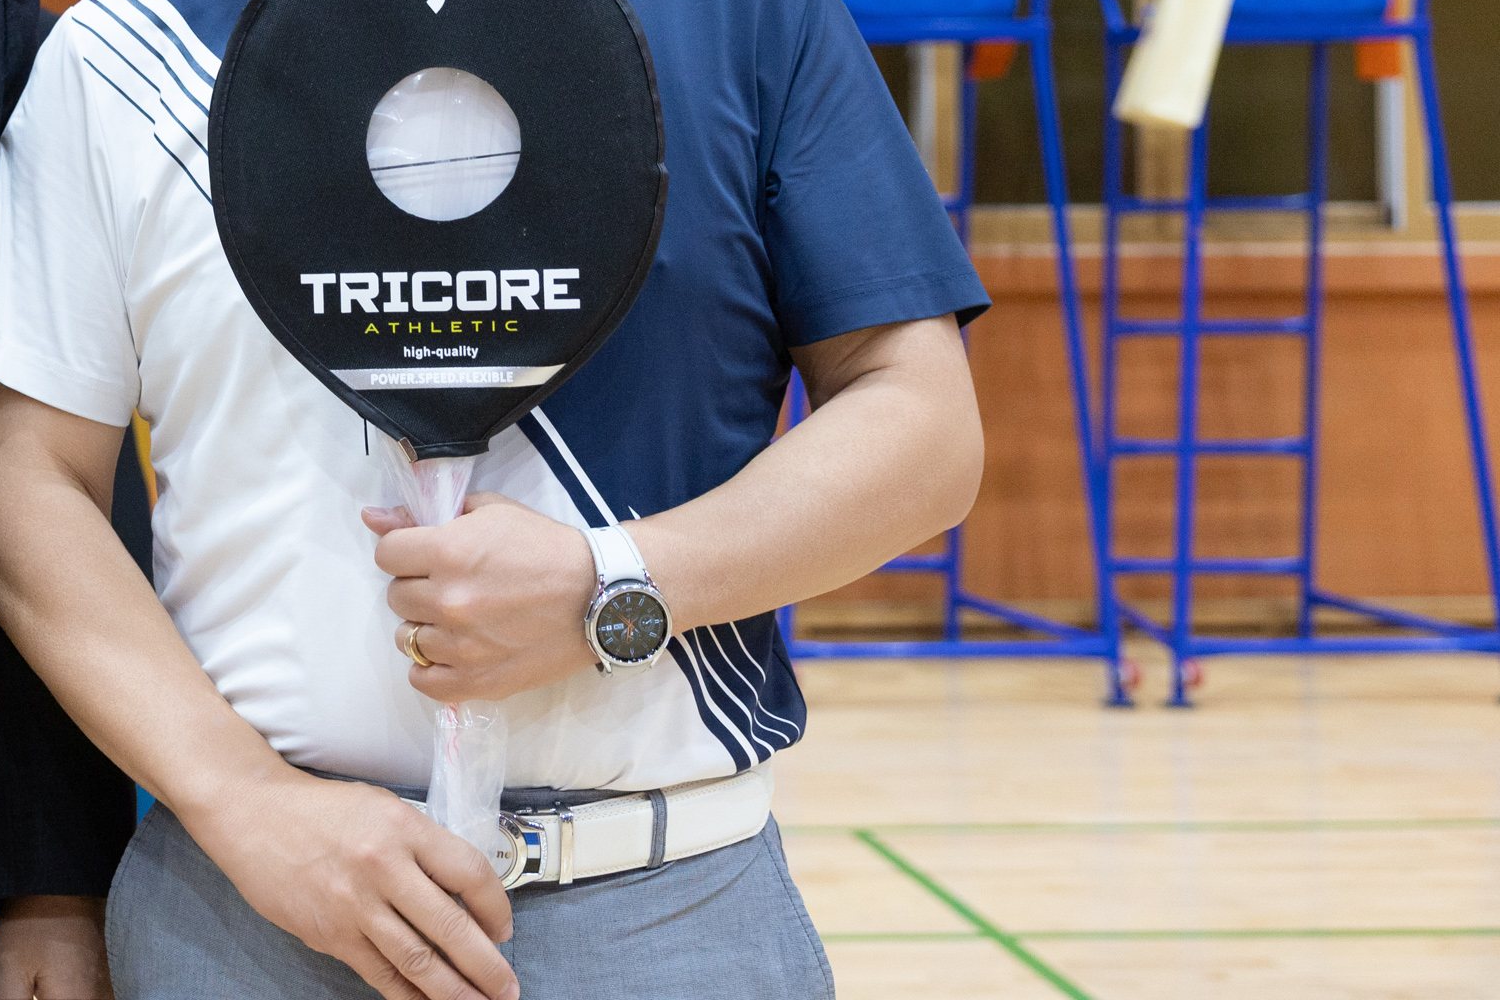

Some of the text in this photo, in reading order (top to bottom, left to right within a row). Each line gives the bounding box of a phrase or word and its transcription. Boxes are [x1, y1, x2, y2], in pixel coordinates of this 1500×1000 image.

[300, 268, 581, 314] TRICORE
[364, 320, 519, 334] ATHLETIC
[403, 346, 479, 360] high-quality
[370, 371, 514, 386] POWER.SPEED.FLEXIBLE
